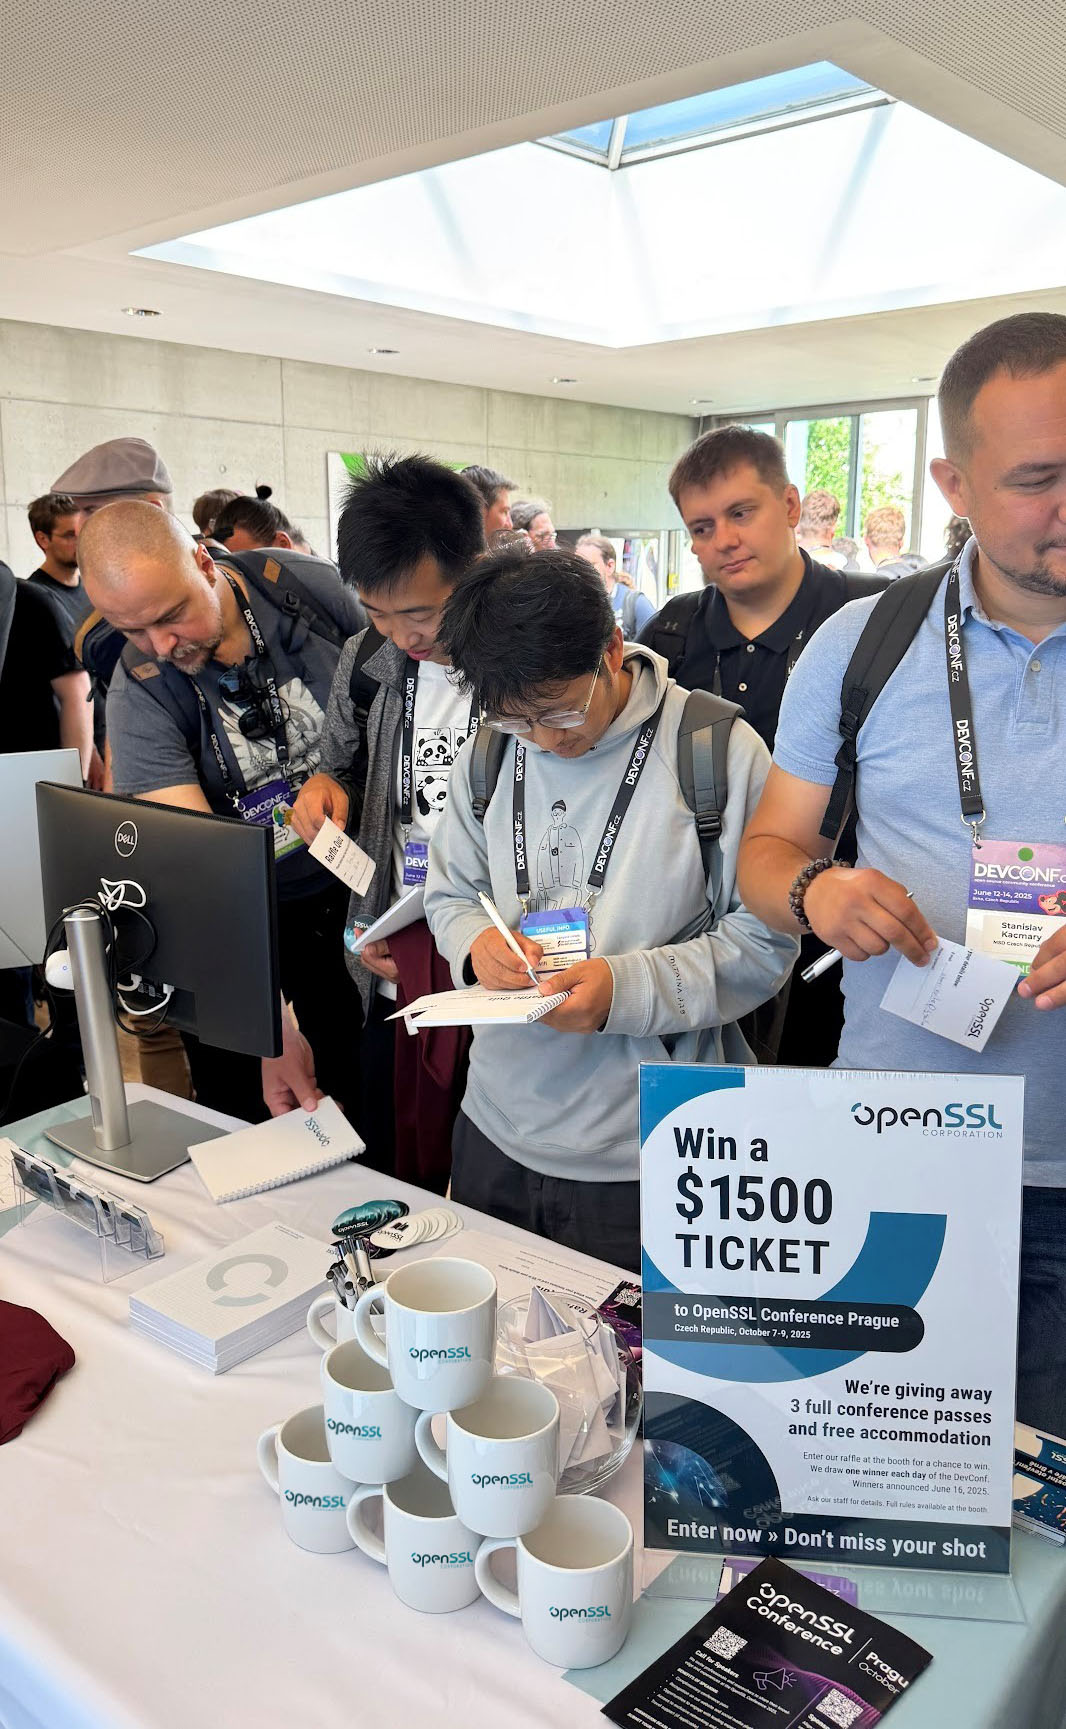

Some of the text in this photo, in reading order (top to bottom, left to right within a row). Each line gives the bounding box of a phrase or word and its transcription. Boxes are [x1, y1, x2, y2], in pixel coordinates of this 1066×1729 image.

[948, 614, 963, 682] DEVCONF.cz
[625, 728, 653, 785] DEVCONF.cz
[956, 719, 974, 792] DEVCONF.cz
[118, 833, 134, 845] DELL
[514, 811, 525, 869] DEVCONF.cz
[595, 815, 621, 872] DEVCONF.cz
[993, 891, 1013, 899] 12-14,
[1001, 931, 1042, 941] Kacmary
[1002, 922, 1043, 932] Stanislav
[673, 1127, 768, 1162] Win a
[923, 1129, 1003, 1139] CORPORATION
[675, 1166, 832, 1225] $1500
[675, 1234, 830, 1275] TICKET
[674, 1304, 899, 1329] to OpenSSL Conference Prague
[674, 1323, 811, 1339] Czech Republic, October 7-9, 2025
[845, 1379, 992, 1404] We're giving away
[790, 1399, 992, 1424] 3 full conference passes
[788, 1422, 991, 1446] and free accommodation
[803, 1452, 823, 1461] Enter
[840, 1454, 860, 1463] raffle
[873, 1456, 885, 1464] the
[888, 1457, 910, 1466] booth
[913, 1458, 923, 1466] for
[933, 1460, 961, 1468] chance
[824, 1466, 844, 1474] draw
[862, 1468, 888, 1477] winner
[891, 1470, 910, 1478] each
[912, 1470, 926, 1480] day
[939, 1472, 951, 1480] the
[954, 1473, 990, 1483] DevConf.
[852, 1479, 989, 1495] Winners announced June 16, 2025.
[861, 1499, 884, 1507] details.
[886, 1500, 897, 1508] Full
[917, 1502, 946, 1510] available
[956, 1504, 967, 1512] the
[667, 1518, 717, 1540] Enter
[723, 1526, 761, 1543] now
[784, 1528, 834, 1549] Don't
[840, 1532, 886, 1552] miss
[892, 1536, 936, 1557] your
[941, 1538, 986, 1558] shot
[747, 1596, 843, 1656] Conference
[695, 1650, 739, 1678] Call for Speakers
[859, 1662, 900, 1694] October
